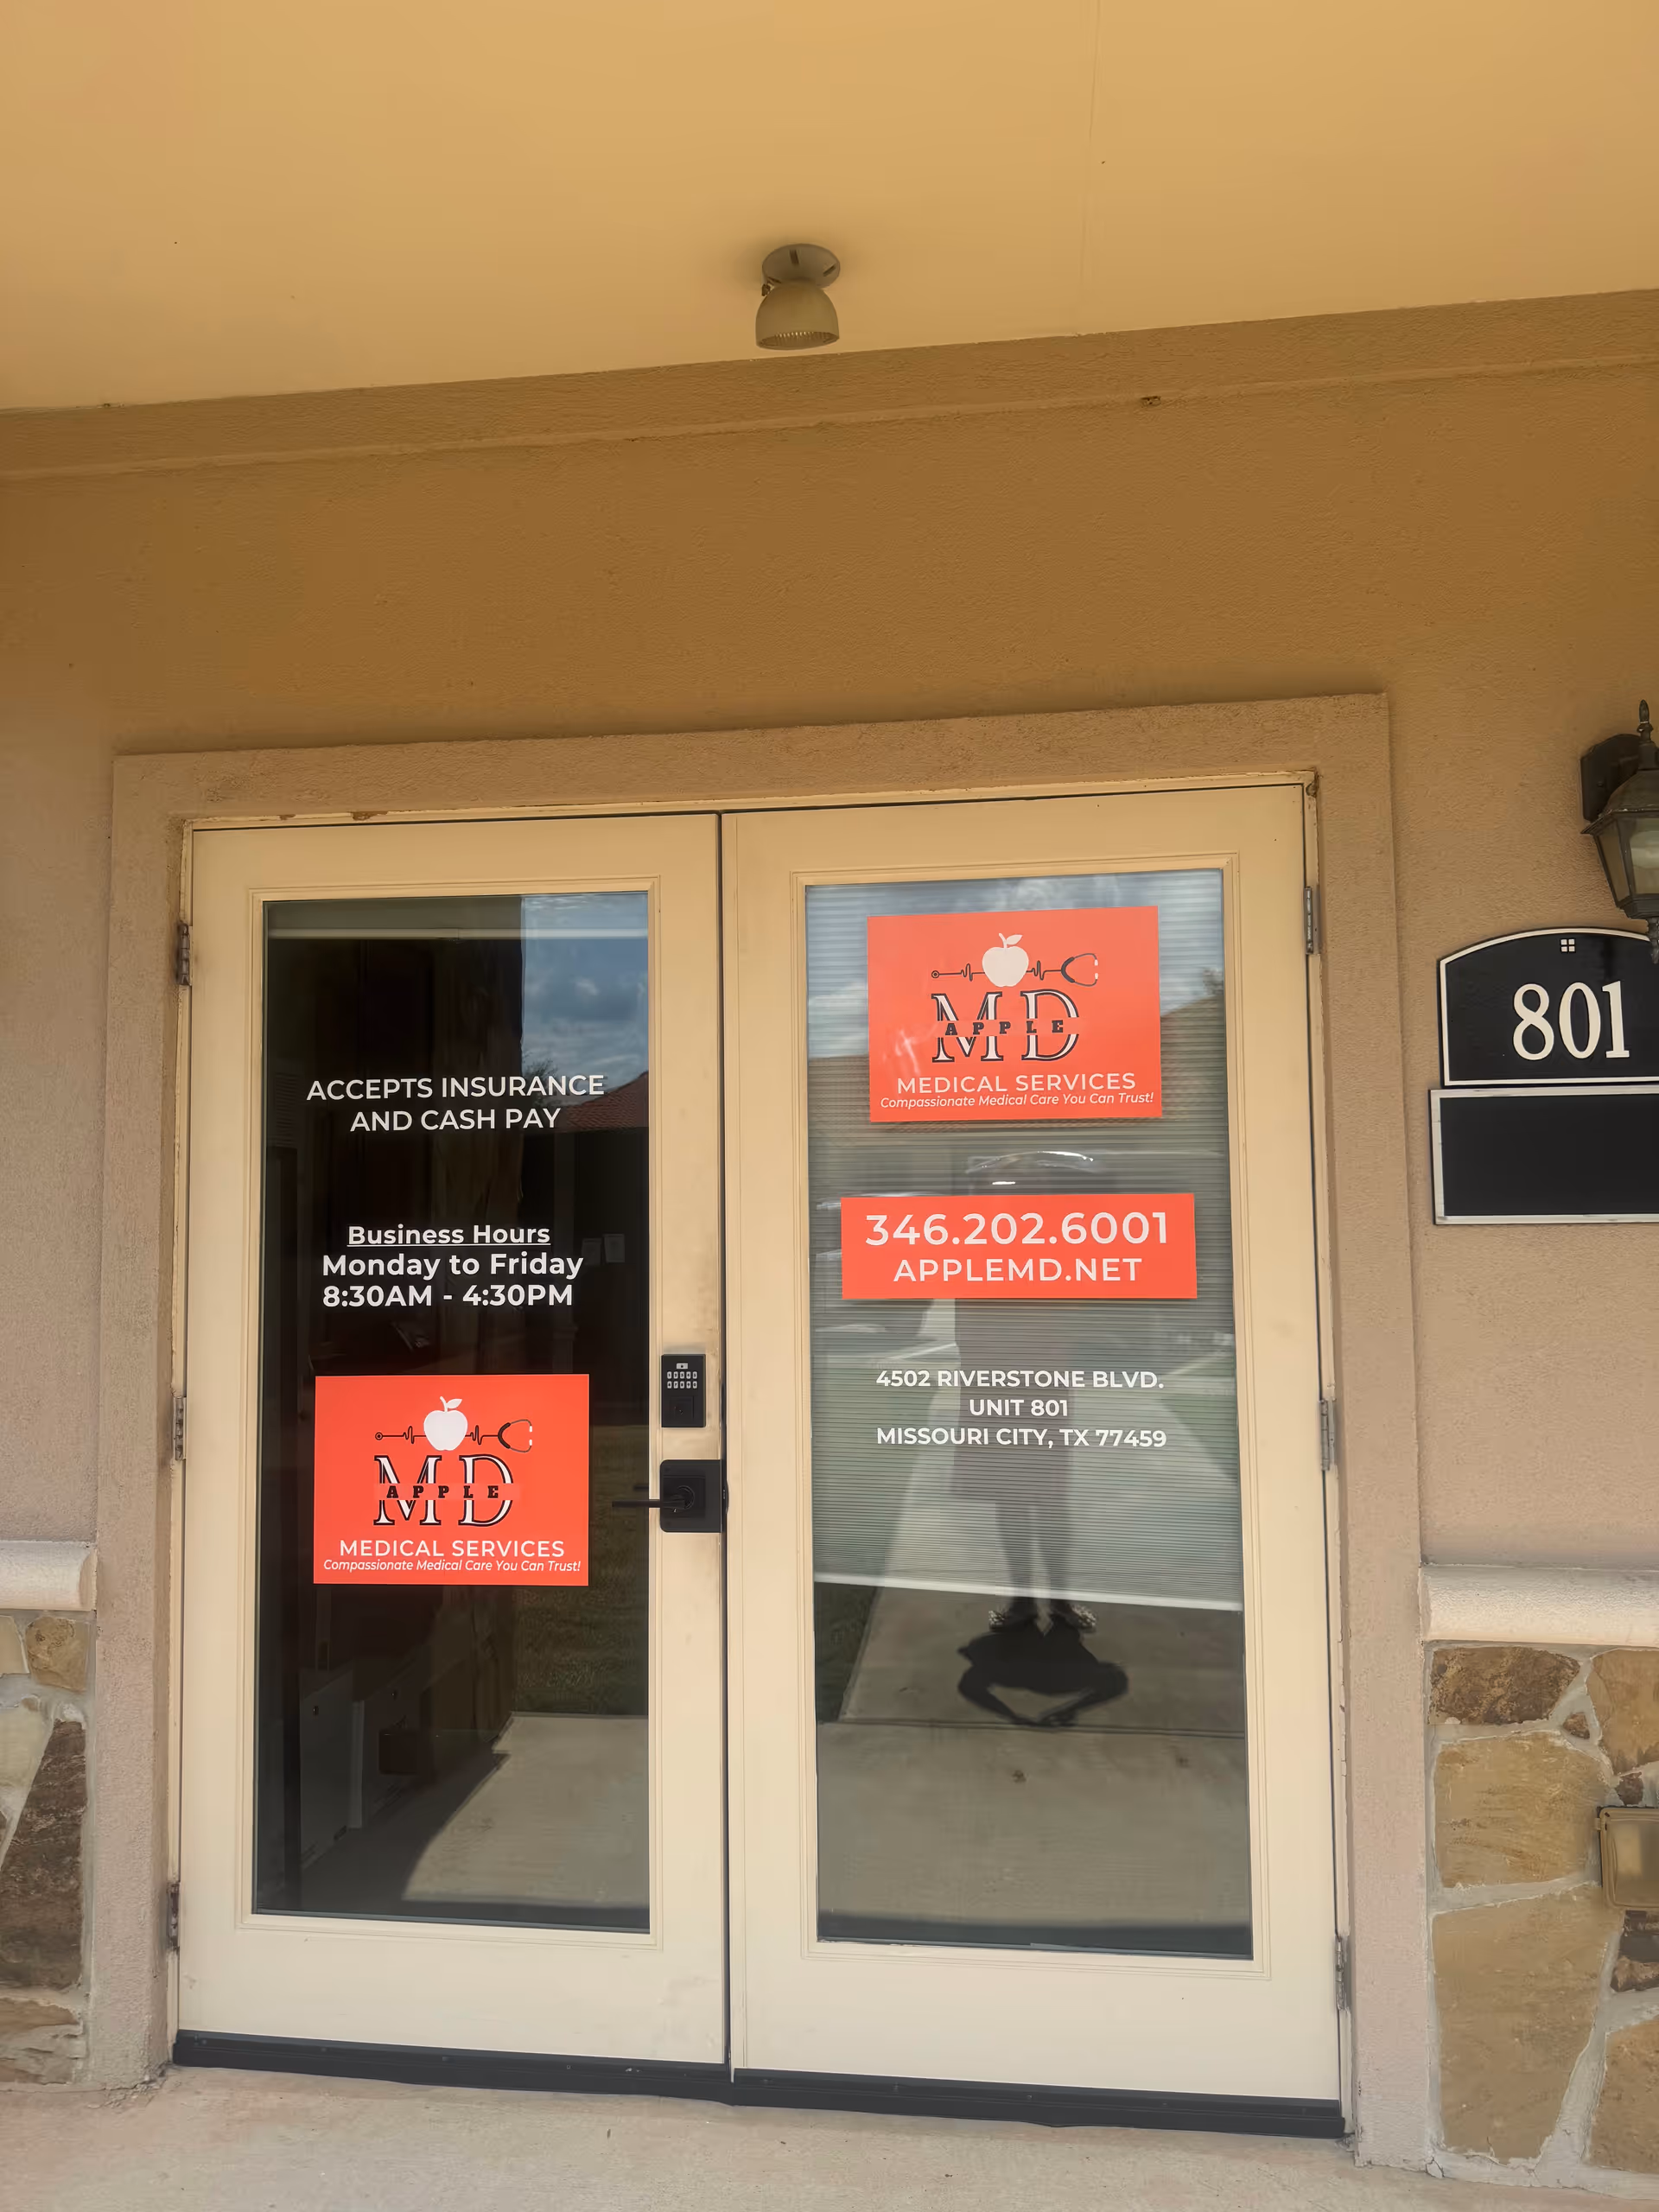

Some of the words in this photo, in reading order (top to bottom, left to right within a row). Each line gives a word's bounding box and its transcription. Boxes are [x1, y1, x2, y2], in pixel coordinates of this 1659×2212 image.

[944, 1020, 1065, 1036] APPLE
[1513, 981, 1630, 1061] 801
[307, 1077, 433, 1101] ACCEPTS
[442, 1074, 605, 1098] INSURANCE
[897, 1076, 1007, 1095] MEDICAL
[1015, 1072, 1136, 1092] SERVICES
[880, 1094, 976, 1109] Compassionate
[978, 1093, 1027, 1106] Medical
[1030, 1092, 1059, 1105] Care
[1063, 1093, 1086, 1105] You
[1089, 1092, 1115, 1104] Can
[1118, 1092, 1154, 1103] Trust!
[350, 1111, 412, 1132] AND
[421, 1109, 496, 1130] CASH
[505, 1107, 562, 1129] PAY
[347, 1223, 464, 1247] Business
[473, 1224, 551, 1245] Hours
[865, 1211, 1167, 1246] 346.202.6001
[322, 1253, 441, 1281] Monday
[449, 1255, 480, 1274] to
[490, 1251, 584, 1280] Friday
[893, 1257, 1142, 1282] APPLEMD.NET
[322, 1285, 432, 1307] 8:30AM
[462, 1284, 573, 1306] 4:30PM
[876, 1370, 931, 1388] 4502
[938, 1370, 1085, 1389] RIVERSTONE
[1092, 1370, 1165, 1389] BLVD.
[969, 1399, 1025, 1417] UNIT
[1030, 1399, 1069, 1417] 801
[877, 1427, 989, 1446] MISSOURI
[995, 1428, 1053, 1449] CITY,
[1059, 1429, 1090, 1446] TX
[1096, 1430, 1167, 1448] 77459
[386, 1485, 499, 1499] APPLE
[339, 1540, 444, 1558] MEDICAL
[451, 1540, 565, 1558] SERVICES
[323, 1559, 414, 1573] Compassionate
[416, 1559, 462, 1572] Medical
[465, 1560, 493, 1572] Care
[495, 1560, 518, 1572] You
[520, 1560, 544, 1572] Can
[548, 1560, 582, 1572] Trust!
